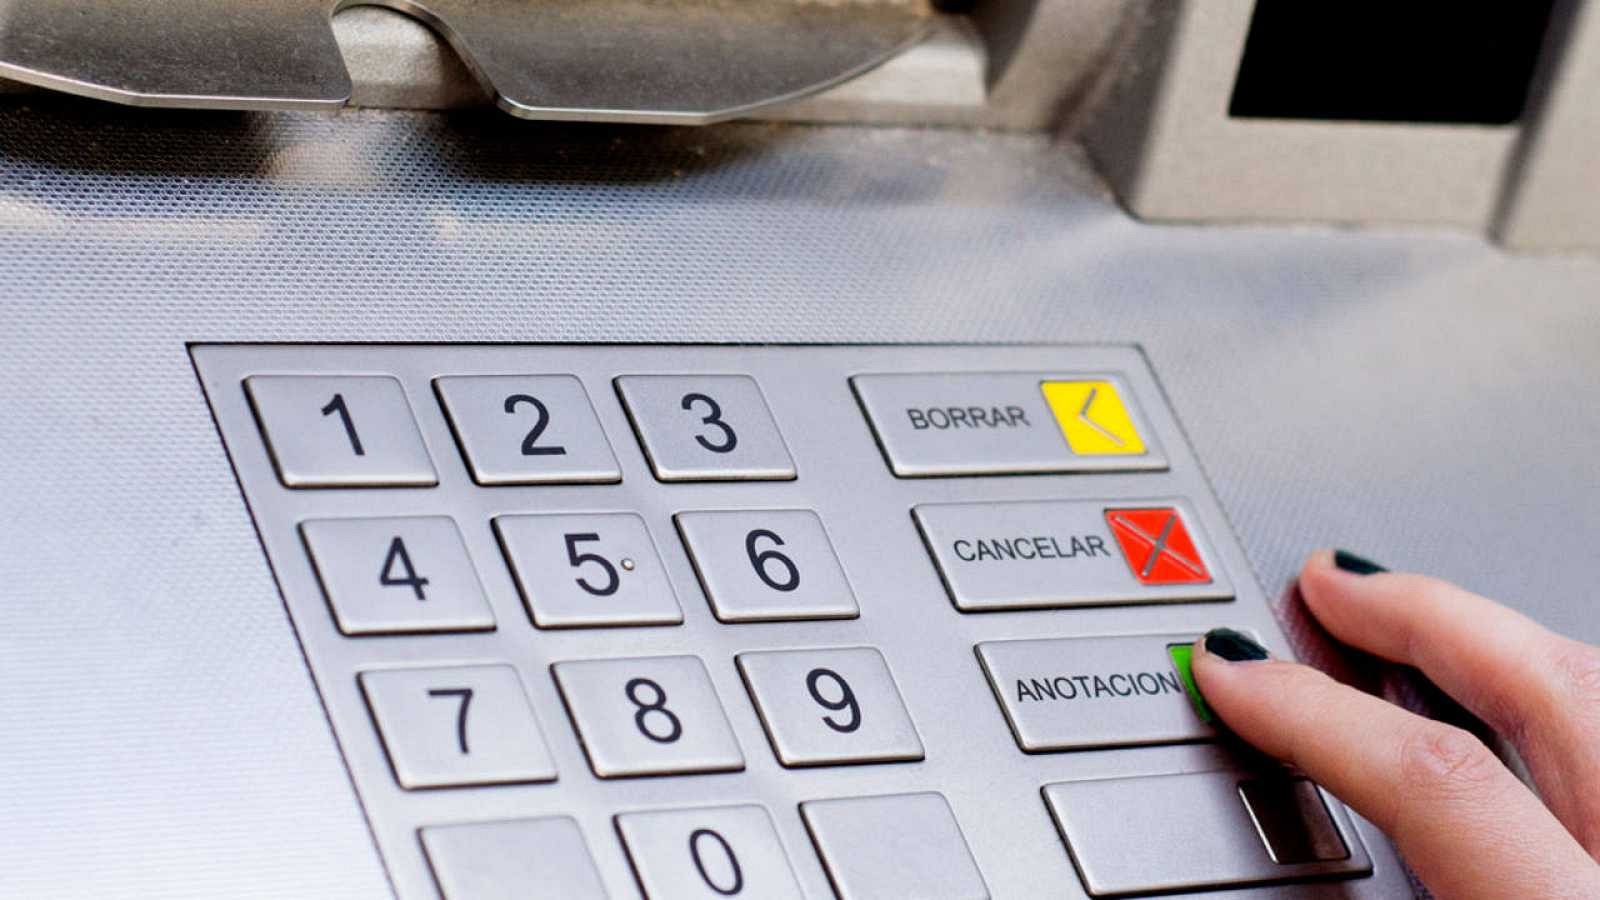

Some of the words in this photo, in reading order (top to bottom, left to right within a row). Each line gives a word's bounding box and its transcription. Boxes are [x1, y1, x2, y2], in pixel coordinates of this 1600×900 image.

[321, 393, 365, 456] 1
[504, 394, 567, 456] 2
[681, 393, 738, 454] 3
[907, 406, 1030, 431] BORRAR
[379, 536, 429, 601] 4
[564, 532, 620, 597] 5
[745, 529, 800, 592] 6
[953, 535, 1111, 562] CANCELAR
[625, 678, 683, 744] 8
[806, 668, 861, 733] 9
[1016, 672, 1180, 702] ANOTACION
[428, 688, 474, 754] 7
[688, 828, 744, 896] 0
